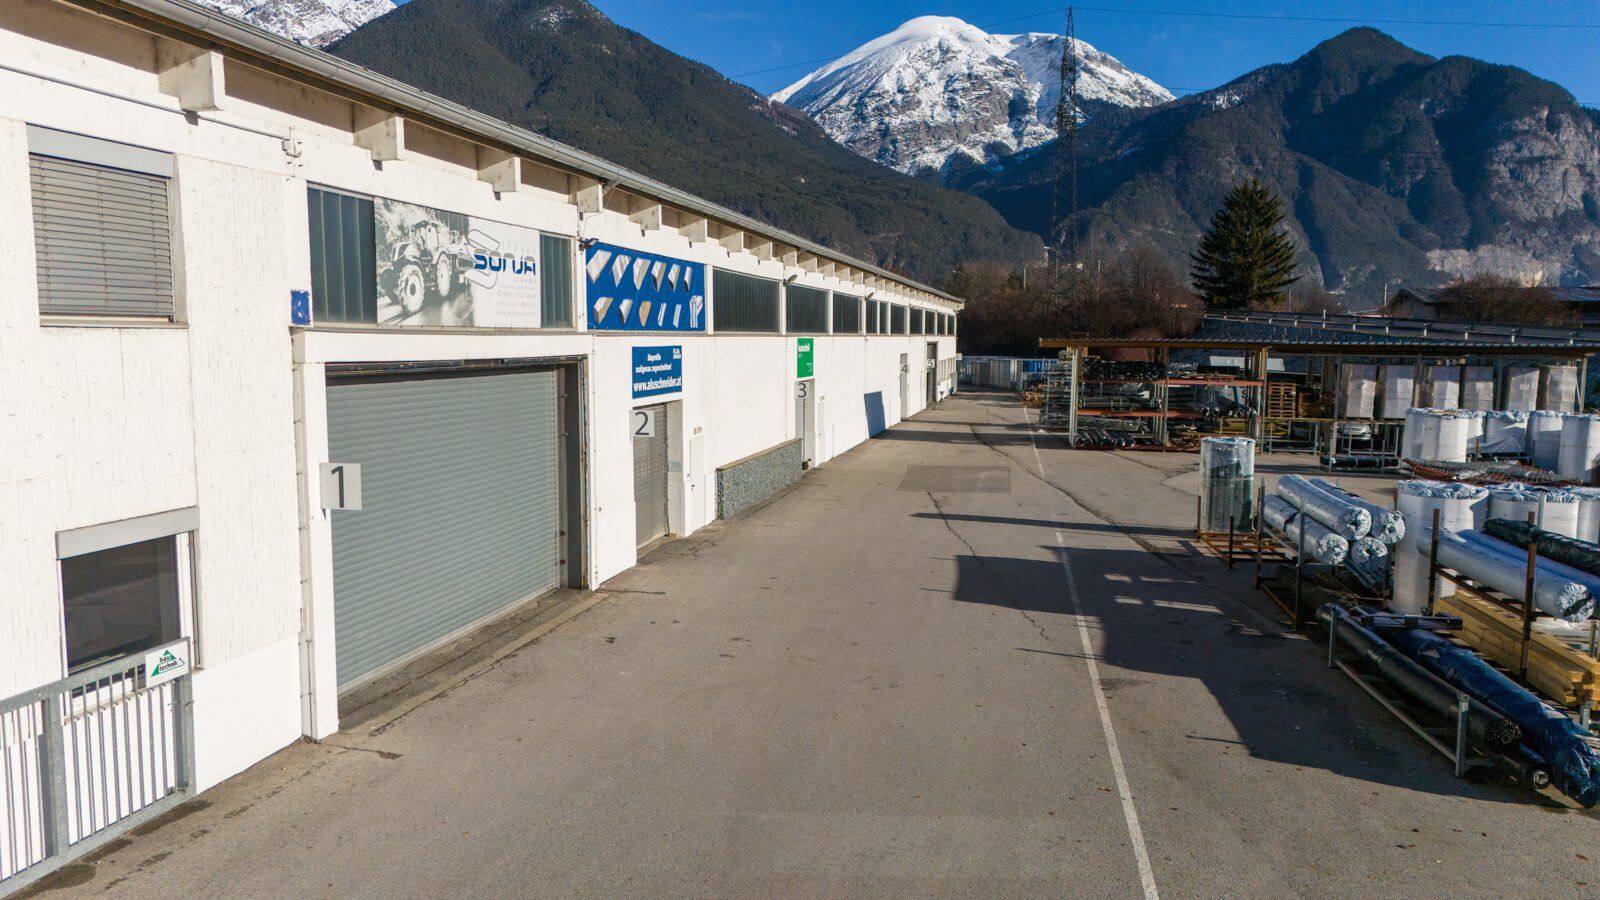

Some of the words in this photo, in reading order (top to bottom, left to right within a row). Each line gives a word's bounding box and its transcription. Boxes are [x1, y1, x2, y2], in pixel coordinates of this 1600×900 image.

[901, 364, 909, 374] 4
[928, 360, 934, 368] 5
[797, 382, 807, 398] 3
[634, 411, 650, 436] 2
[331, 465, 345, 509] 1
